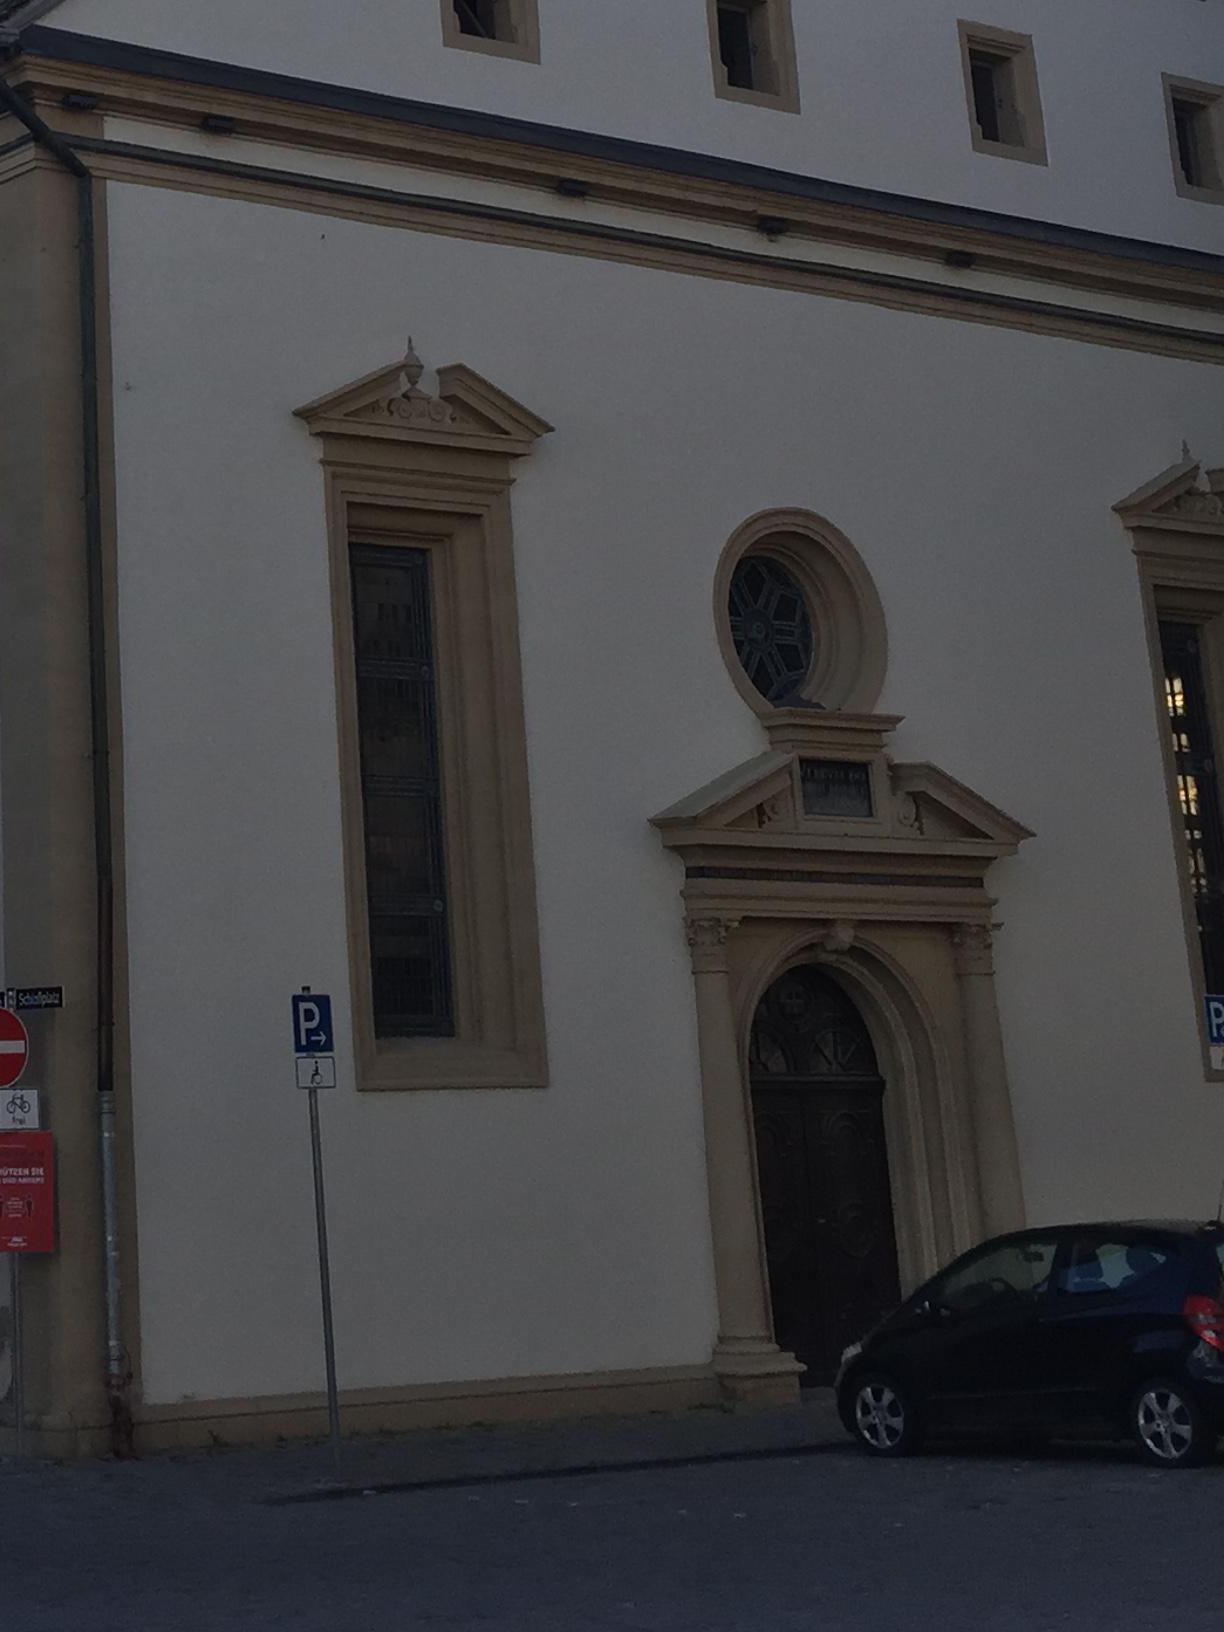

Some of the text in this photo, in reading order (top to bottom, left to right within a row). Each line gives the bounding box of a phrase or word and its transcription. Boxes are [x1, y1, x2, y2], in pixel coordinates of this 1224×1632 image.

[298, 1002, 320, 1046] P
[12, 1115, 26, 1126] frei
[31, 1166, 45, 1176] SIE
